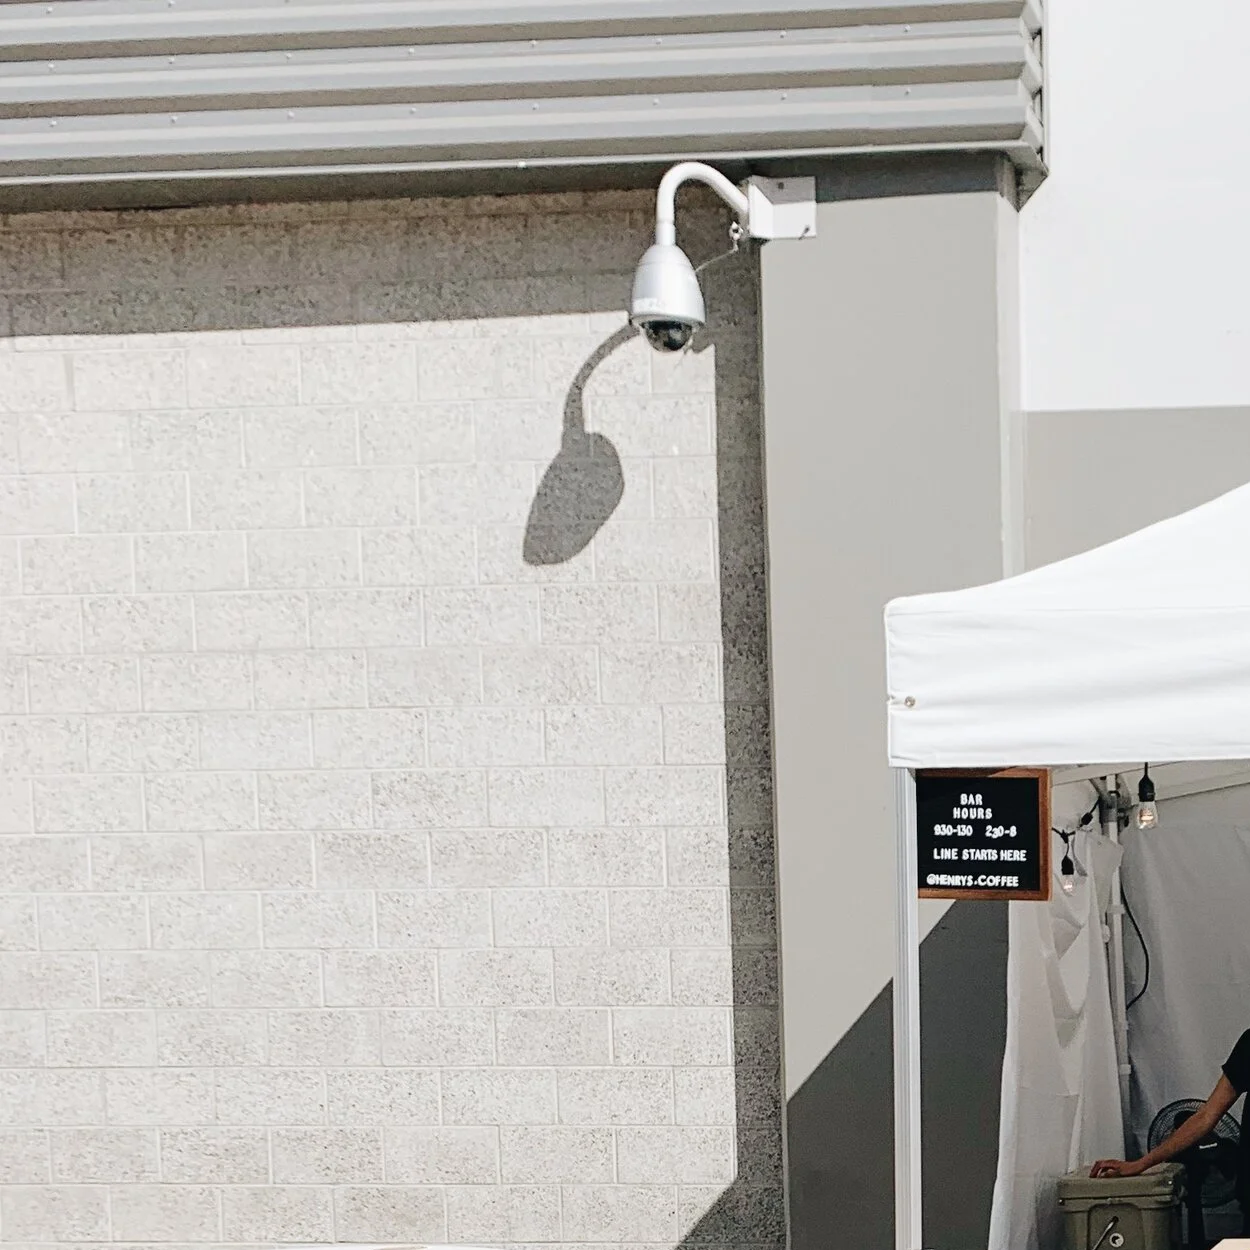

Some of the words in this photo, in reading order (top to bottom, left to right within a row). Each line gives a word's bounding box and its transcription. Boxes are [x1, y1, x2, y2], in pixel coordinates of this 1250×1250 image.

[960, 793, 983, 806] BAR
[953, 807, 993, 820] HOURS
[933, 848, 959, 860] LINE
[961, 848, 998, 861] STARTS
[1000, 849, 1027, 862] HERE
